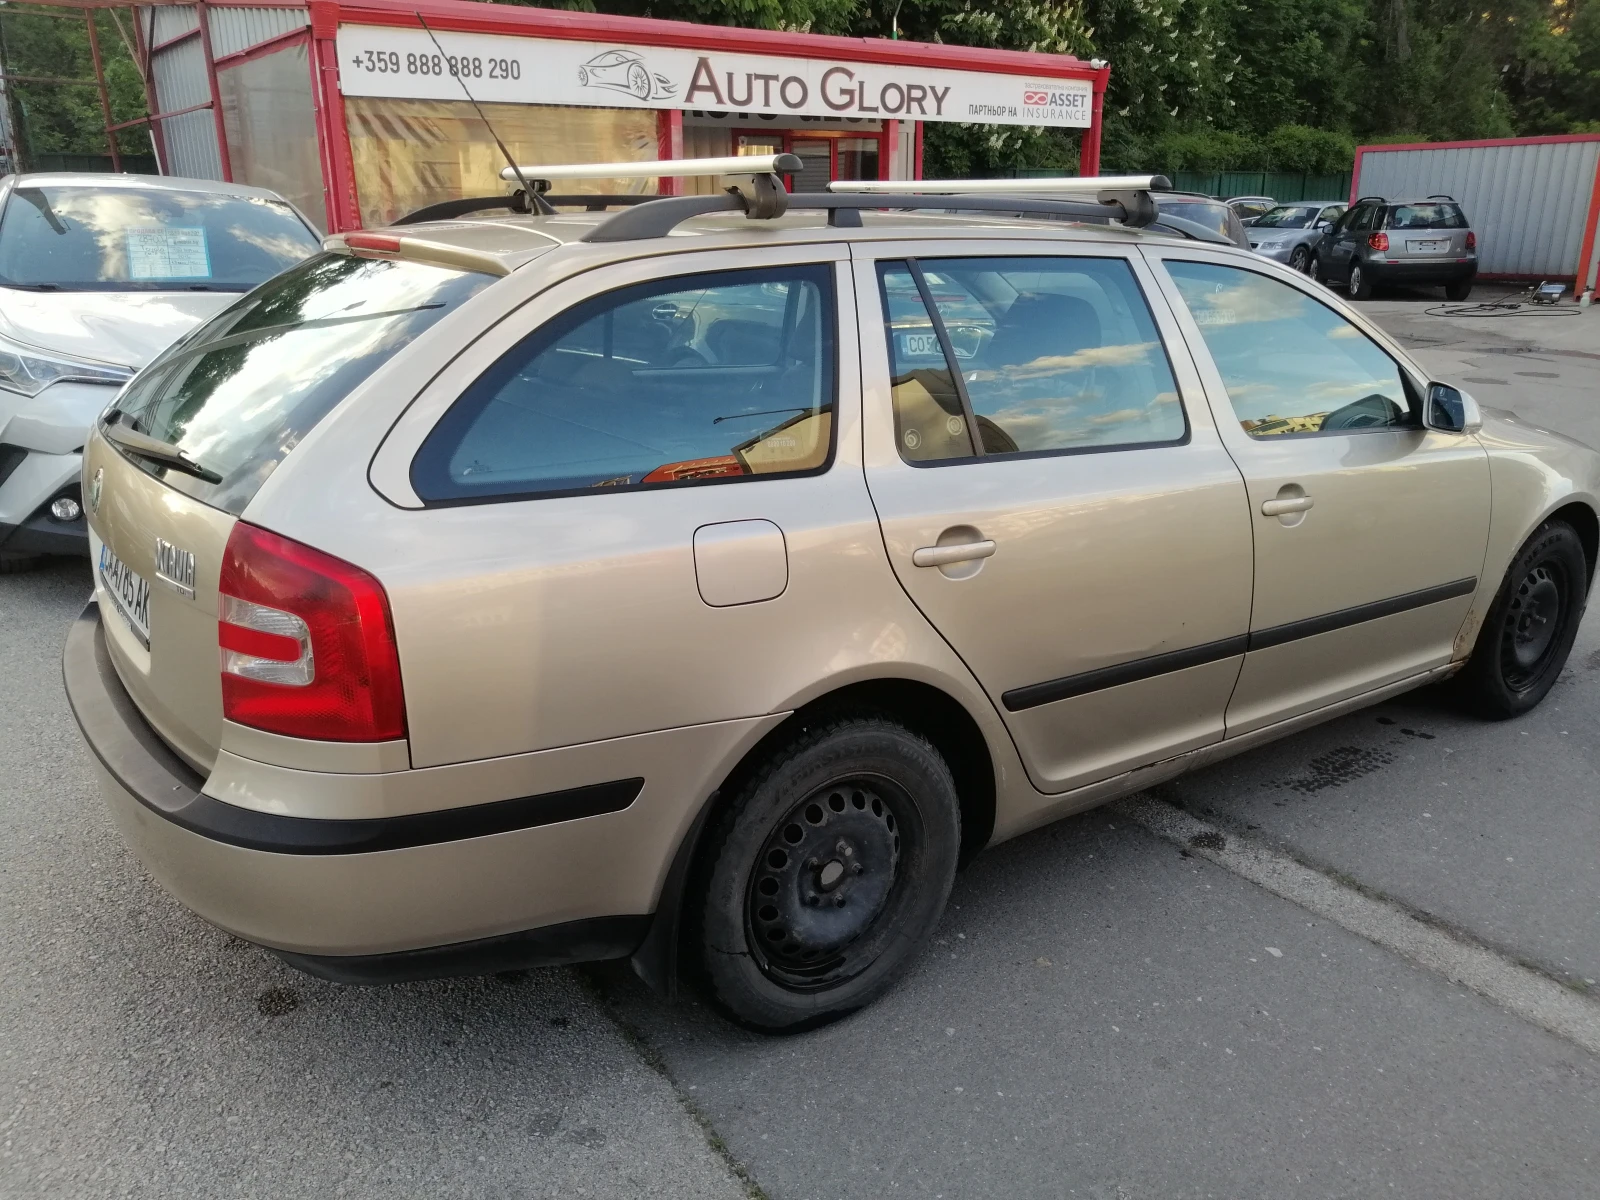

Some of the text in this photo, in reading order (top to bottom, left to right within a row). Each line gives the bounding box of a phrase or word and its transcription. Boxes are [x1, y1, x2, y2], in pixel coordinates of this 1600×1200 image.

[352, 50, 521, 80] +359 888 888 290
[1049, 93, 1086, 107] ASSET
[969, 104, 1017, 117] ПАРТНЬОР НА
[1022, 108, 1086, 120] INSURANCE
